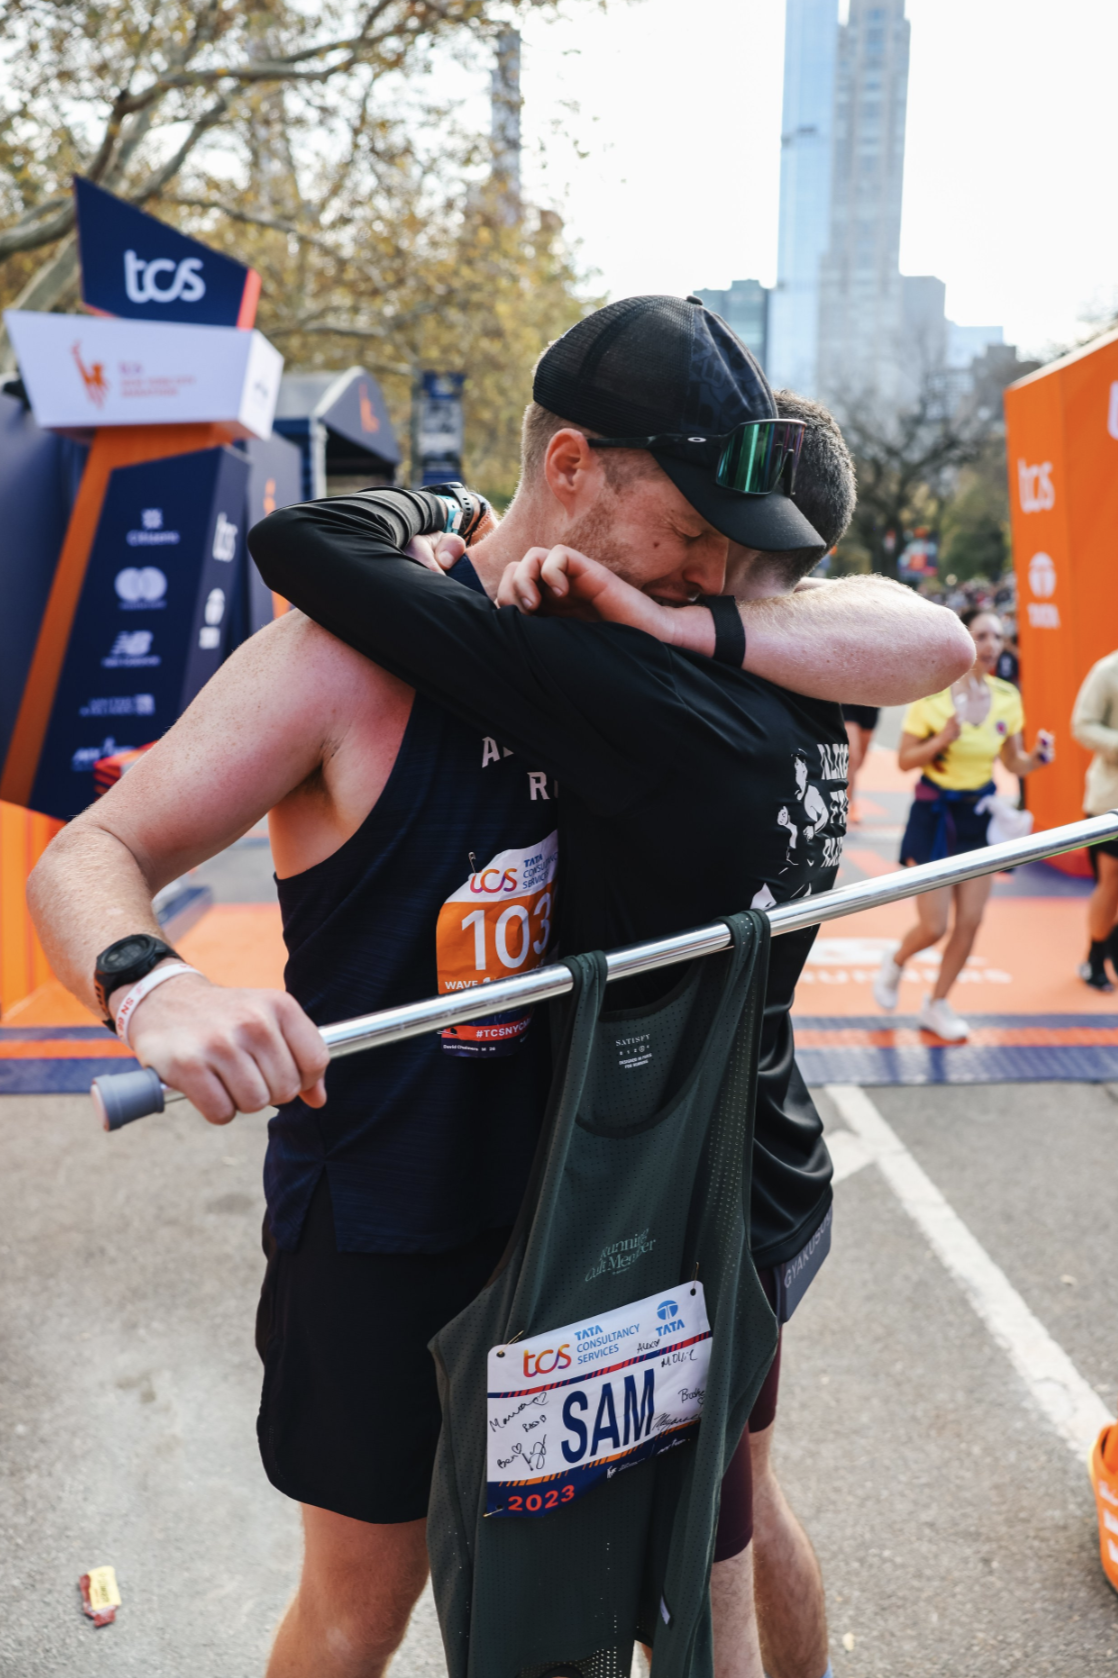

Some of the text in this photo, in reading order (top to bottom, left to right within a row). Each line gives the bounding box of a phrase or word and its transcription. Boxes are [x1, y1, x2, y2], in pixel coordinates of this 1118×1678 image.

[124, 249, 206, 303] tcs
[461, 892, 552, 971] 103
[615, 1033, 651, 1046] SATISFY
[574, 1324, 604, 1341] TATA
[576, 1323, 641, 1354] CONSULTANCY
[655, 1319, 686, 1337] TATA
[522, 1343, 572, 1378] tcs
[576, 1343, 620, 1365] SERVICES
[561, 1368, 656, 1465] SAM
[507, 1484, 575, 1512] 2023
